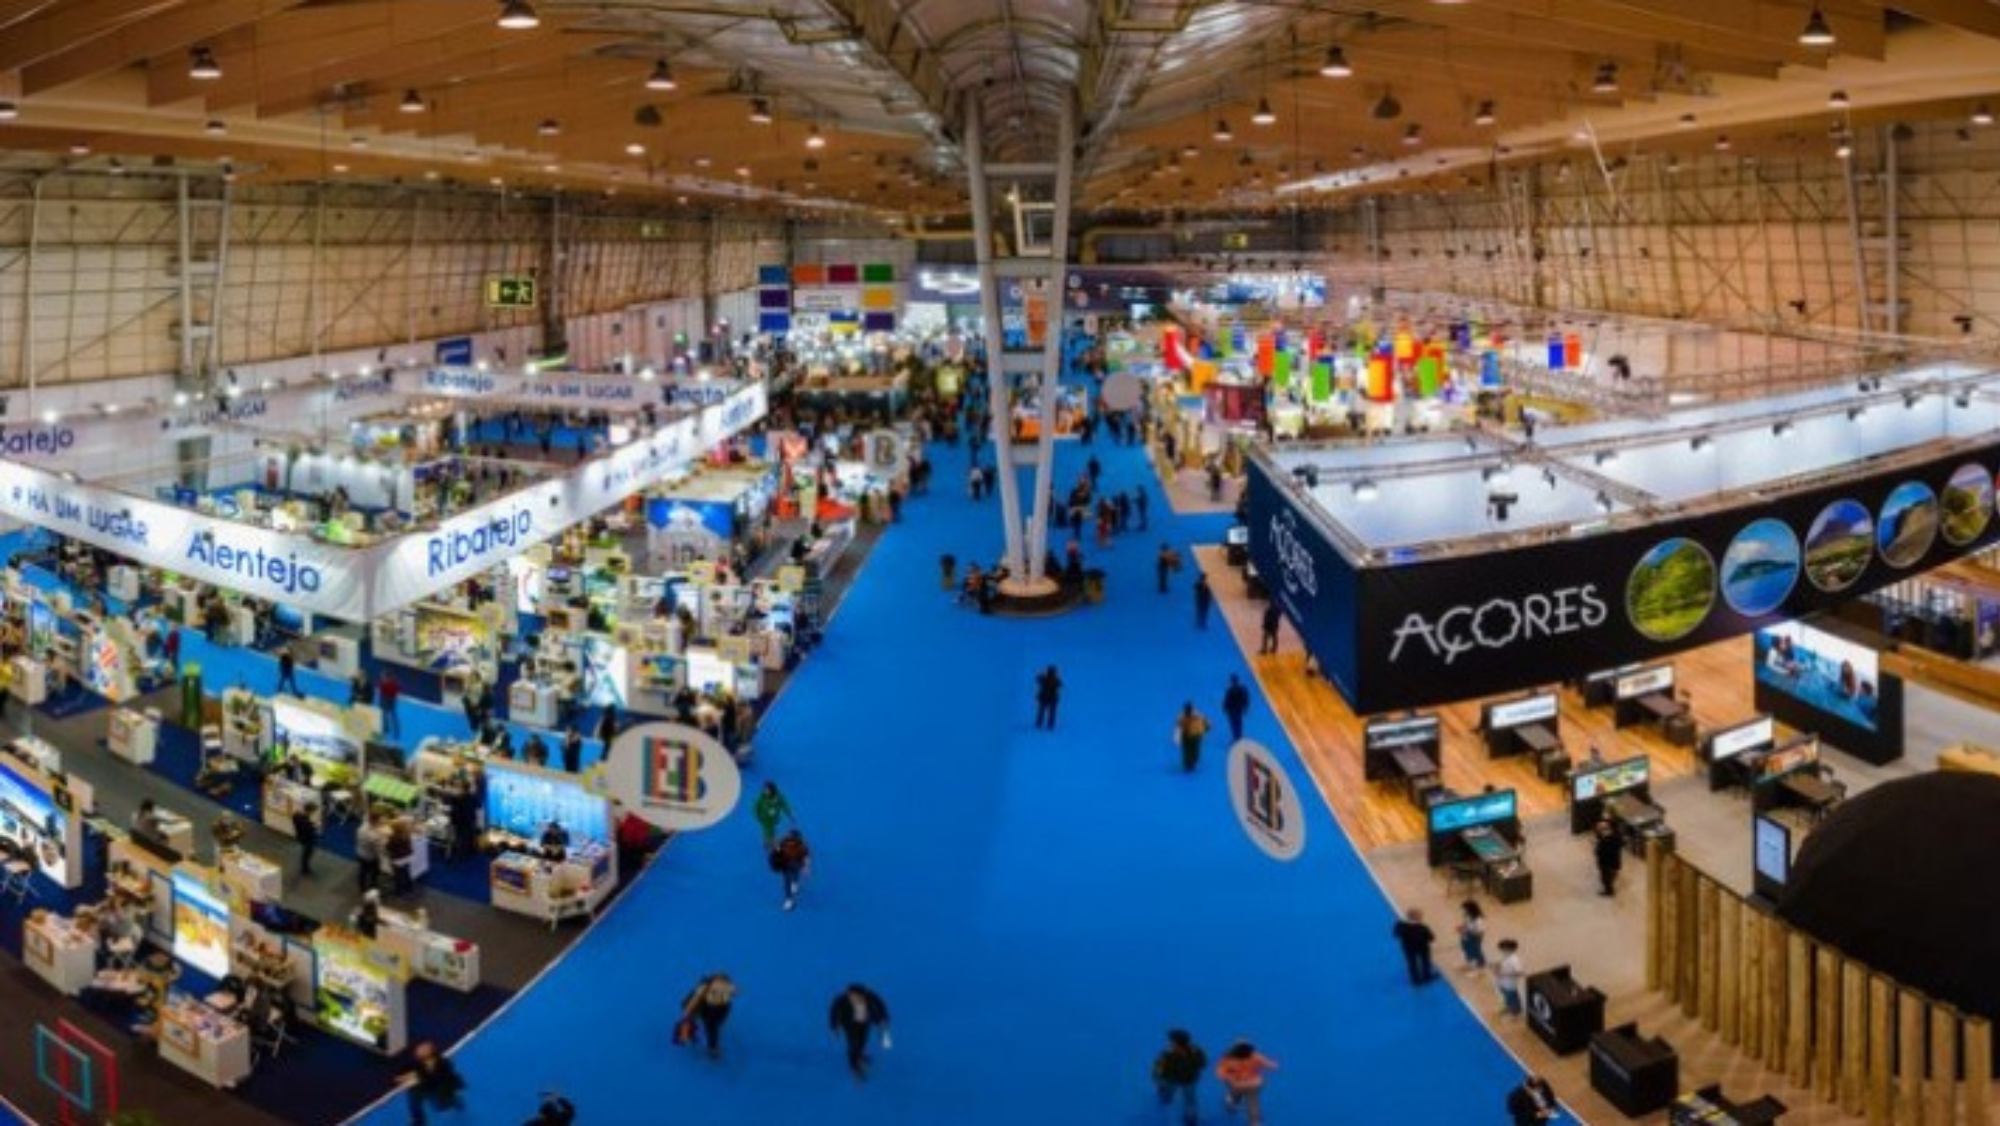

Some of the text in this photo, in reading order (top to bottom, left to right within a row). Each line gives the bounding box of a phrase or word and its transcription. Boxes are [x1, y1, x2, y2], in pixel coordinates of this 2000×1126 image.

[186, 531, 322, 594] Alentejo
[427, 506, 532, 578] Ribatejo
[1388, 583, 1608, 665] AÇORES
